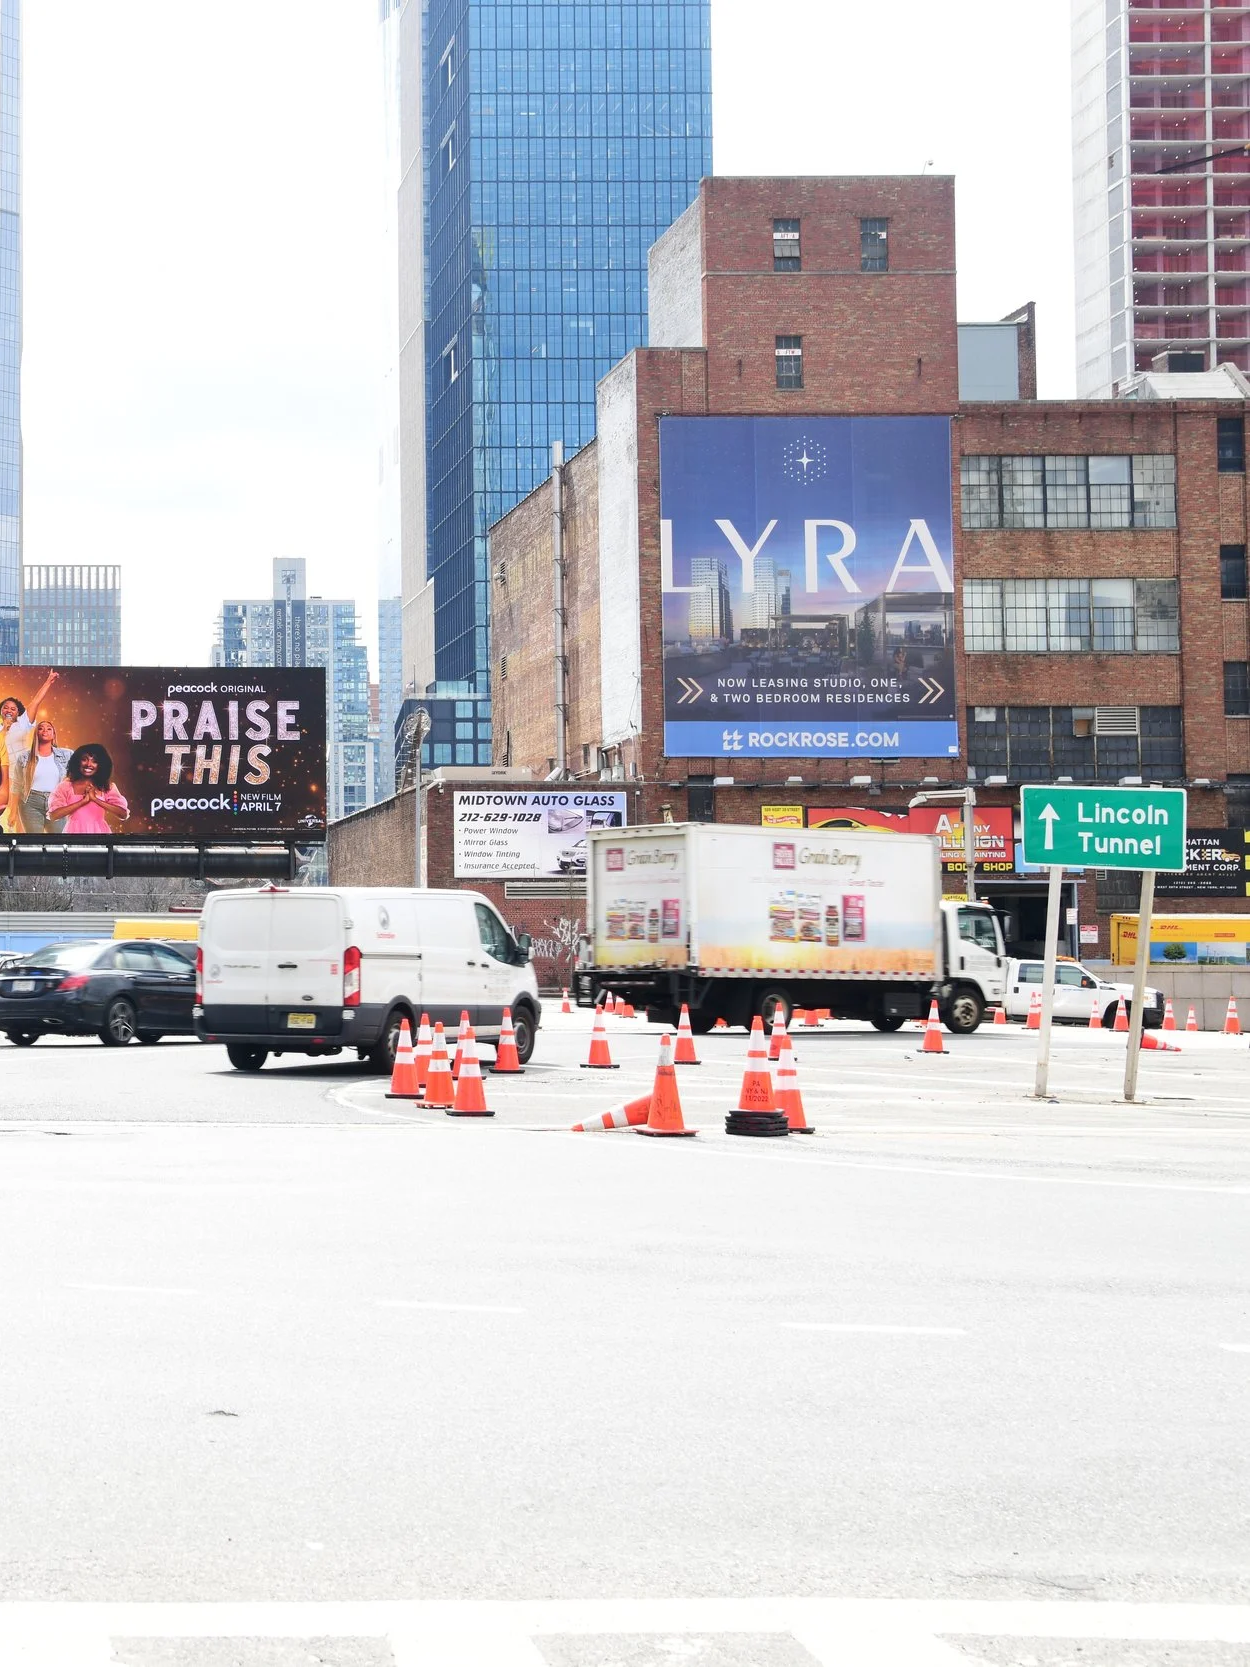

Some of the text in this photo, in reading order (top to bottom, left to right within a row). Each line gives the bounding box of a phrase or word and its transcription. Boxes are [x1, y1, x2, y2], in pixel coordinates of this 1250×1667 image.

[660, 519, 954, 593] LYRA
[295, 643, 300, 652] no
[717, 678, 903, 689] NOW LEASING STUDIO, ONE,
[168, 682, 266, 697] peacock ORIGINAL
[710, 693, 910, 703] & TWO BEDROOM RESIDENCES
[131, 700, 301, 741] PRAISE
[748, 732, 899, 747] ROCKROSE.COM
[164, 744, 272, 785] THIS
[151, 793, 231, 817] peacock
[459, 795, 615, 806] MIDTOWN AUTO GLASS
[240, 802, 282, 811] APRIL 7
[459, 813, 542, 822] 212-629-1028
[1077, 802, 1169, 825] Lincoln
[1078, 832, 1161, 856] Tunnel
[495, 851, 521, 859] Tinting
[463, 862, 500, 870] Insurance
[983, 863, 1013, 871] SHOP
[1123, 931, 1137, 939] DHL
